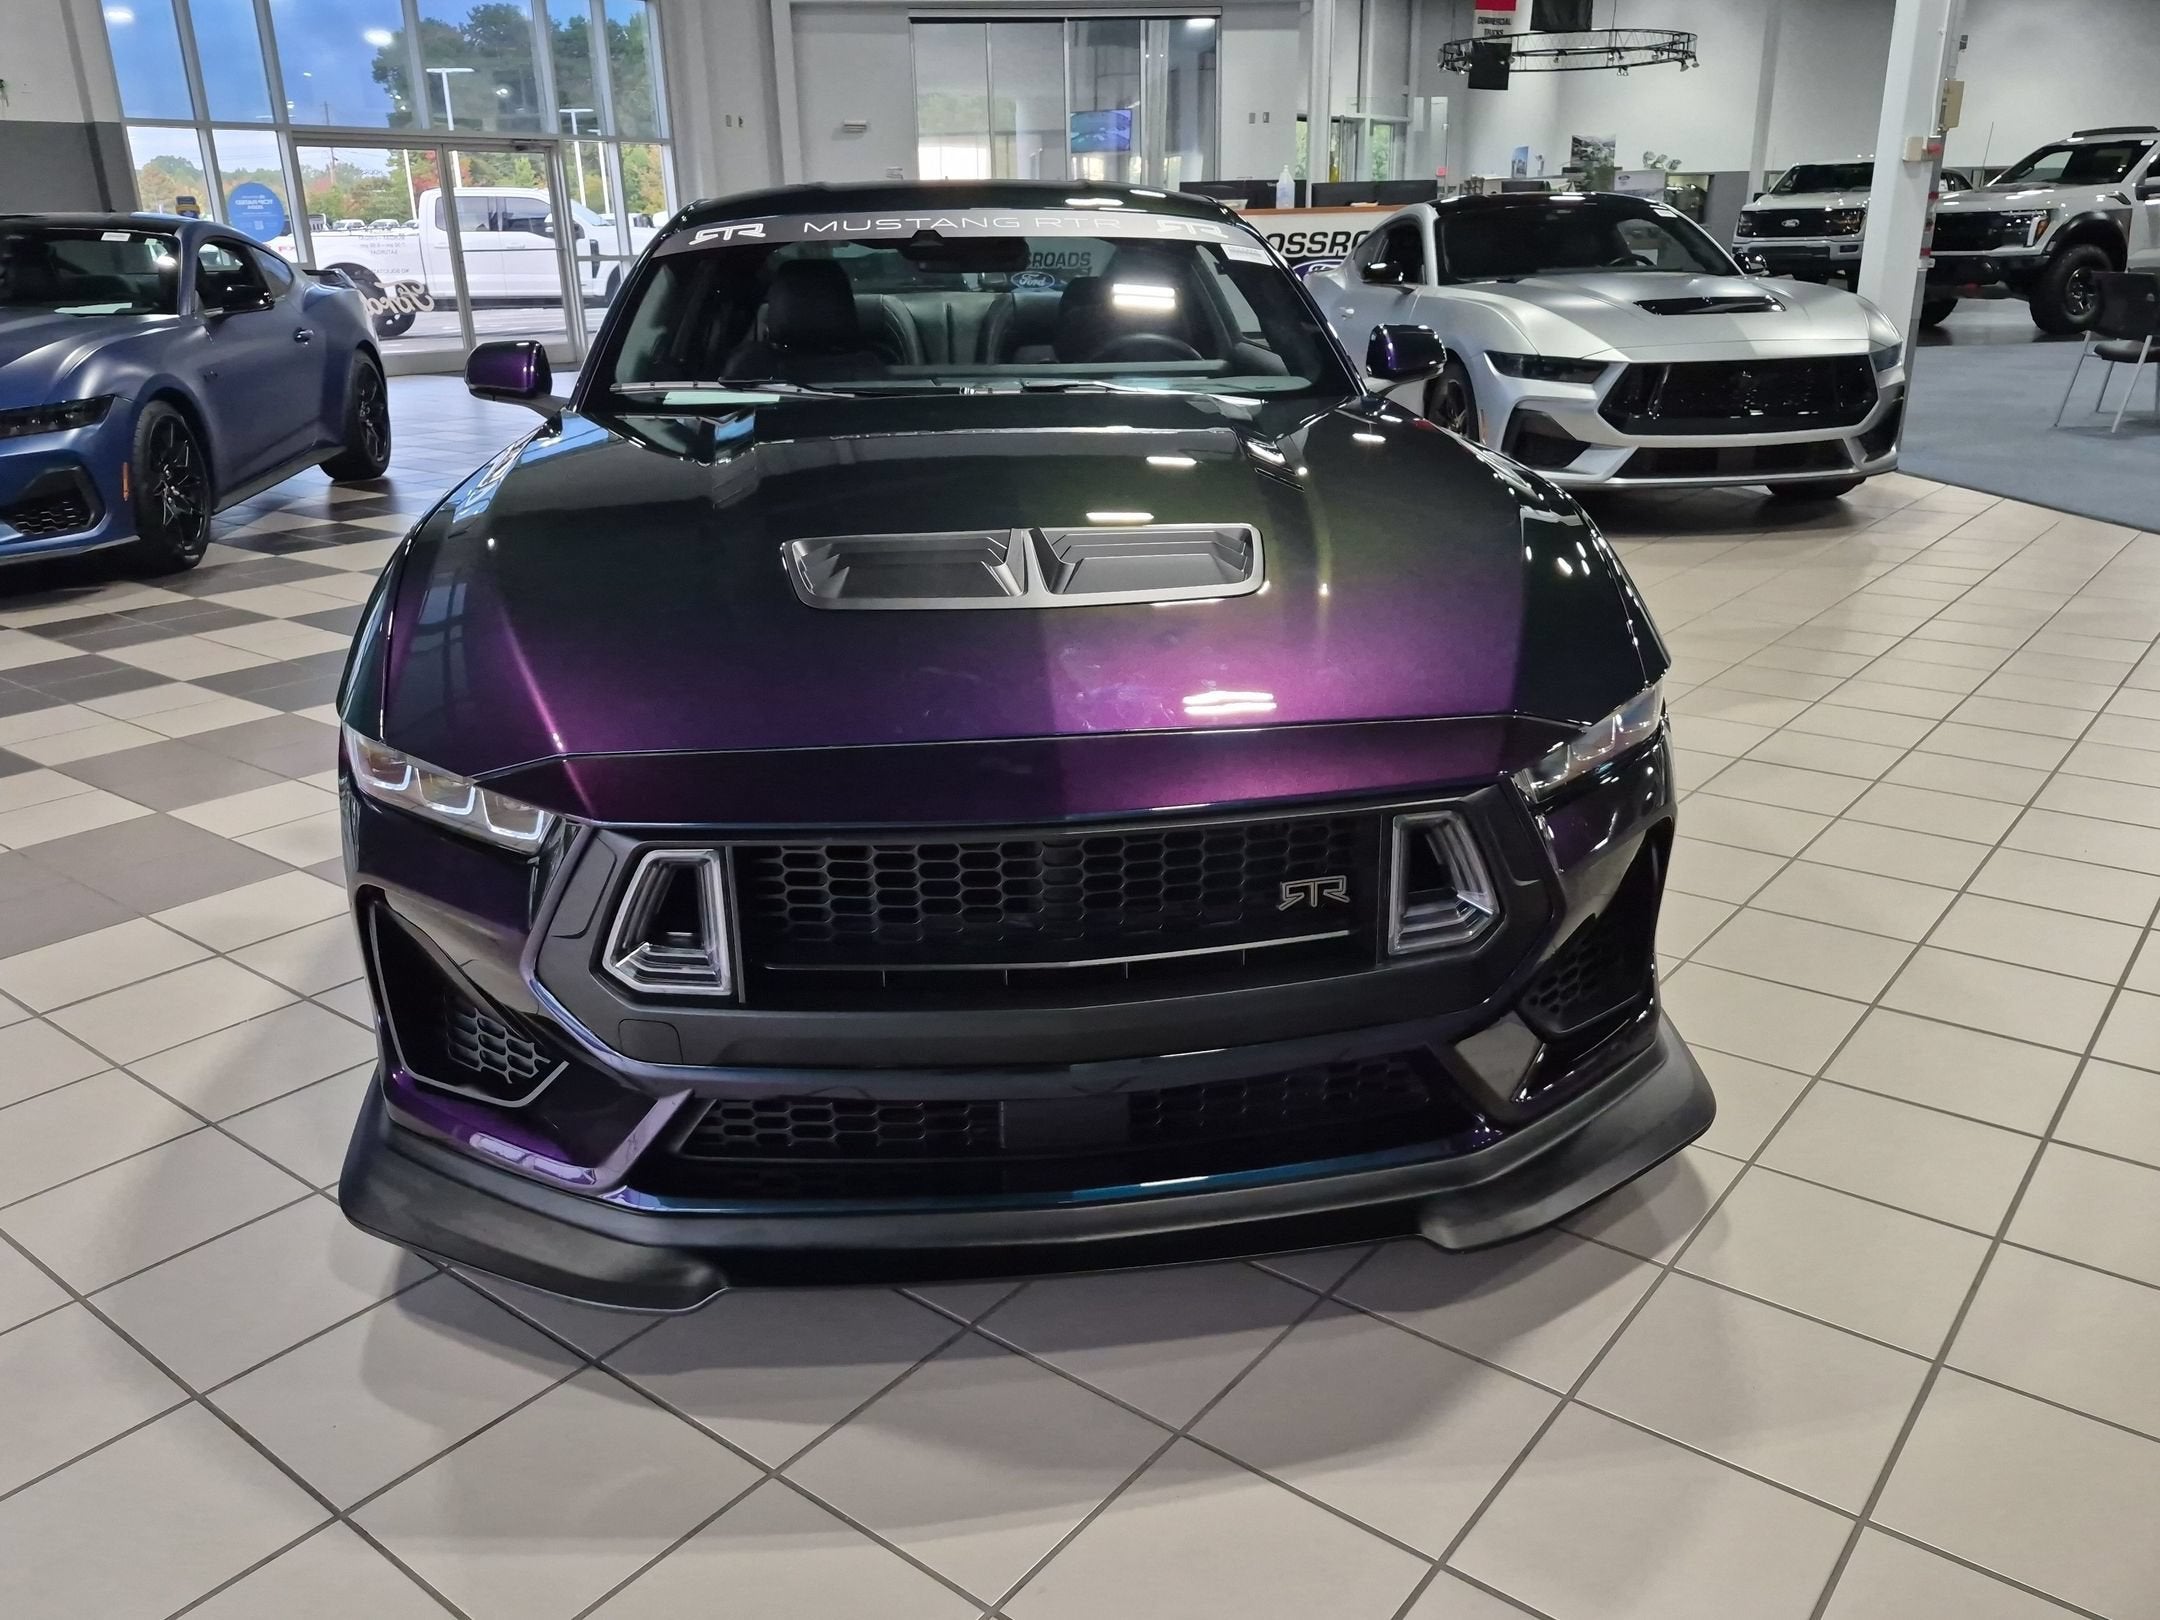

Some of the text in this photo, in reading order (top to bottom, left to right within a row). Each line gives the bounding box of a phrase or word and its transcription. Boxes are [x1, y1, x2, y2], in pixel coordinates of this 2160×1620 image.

[803, 217, 1121, 233] MUSTANG RTR
[1020, 273, 1048, 287] Ford
